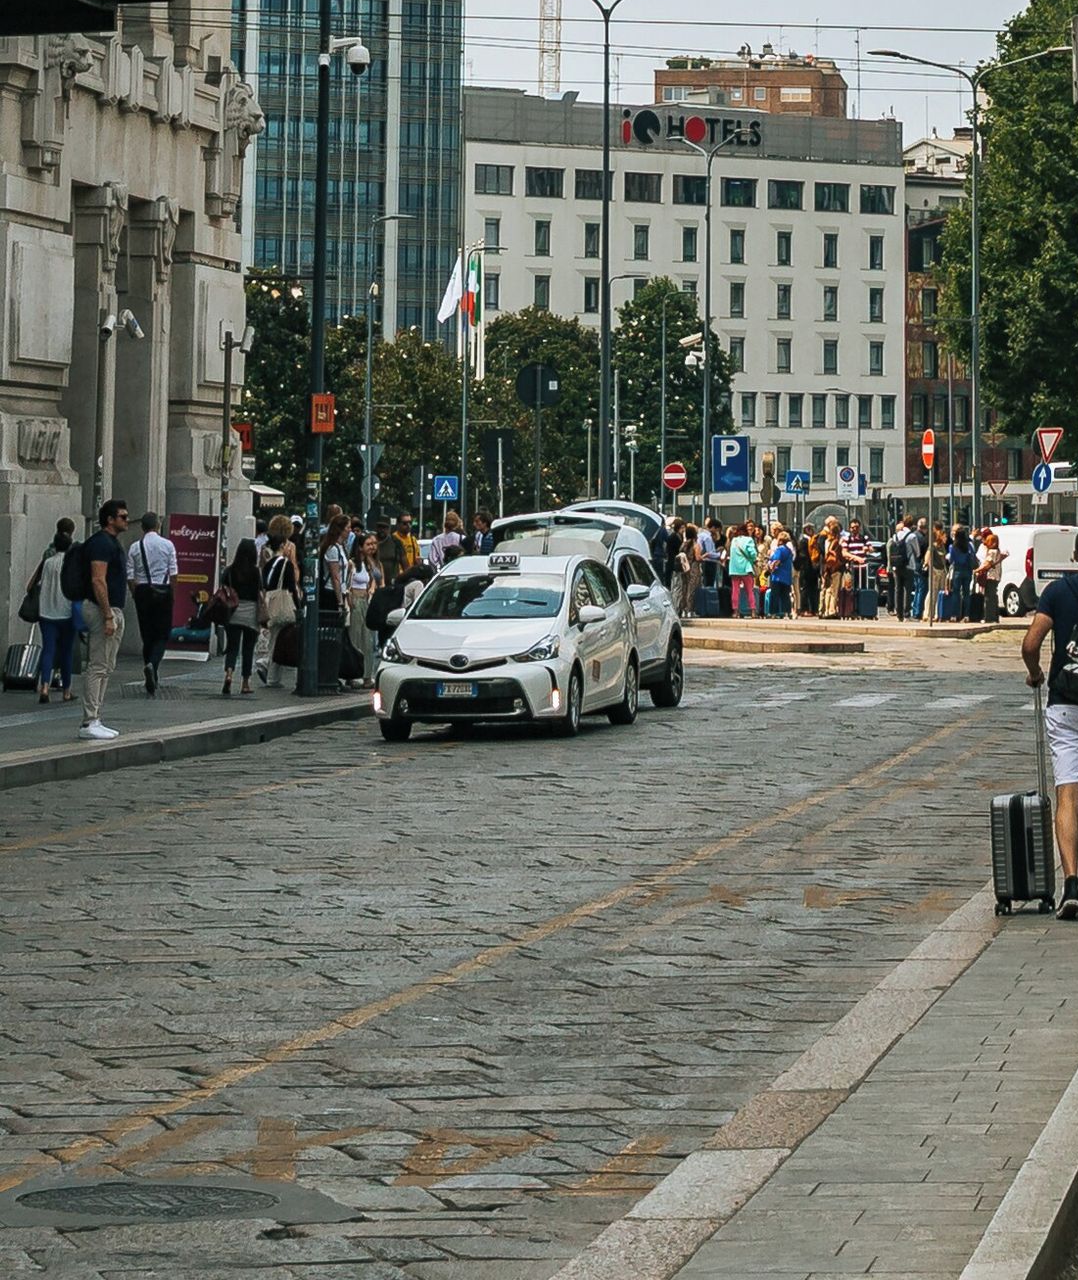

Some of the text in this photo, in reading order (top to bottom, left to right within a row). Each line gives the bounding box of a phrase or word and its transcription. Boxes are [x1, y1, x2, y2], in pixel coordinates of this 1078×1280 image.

[667, 115, 762, 147] HOTELS
[720, 440, 740, 466] P
[491, 554, 516, 563] TAXI
